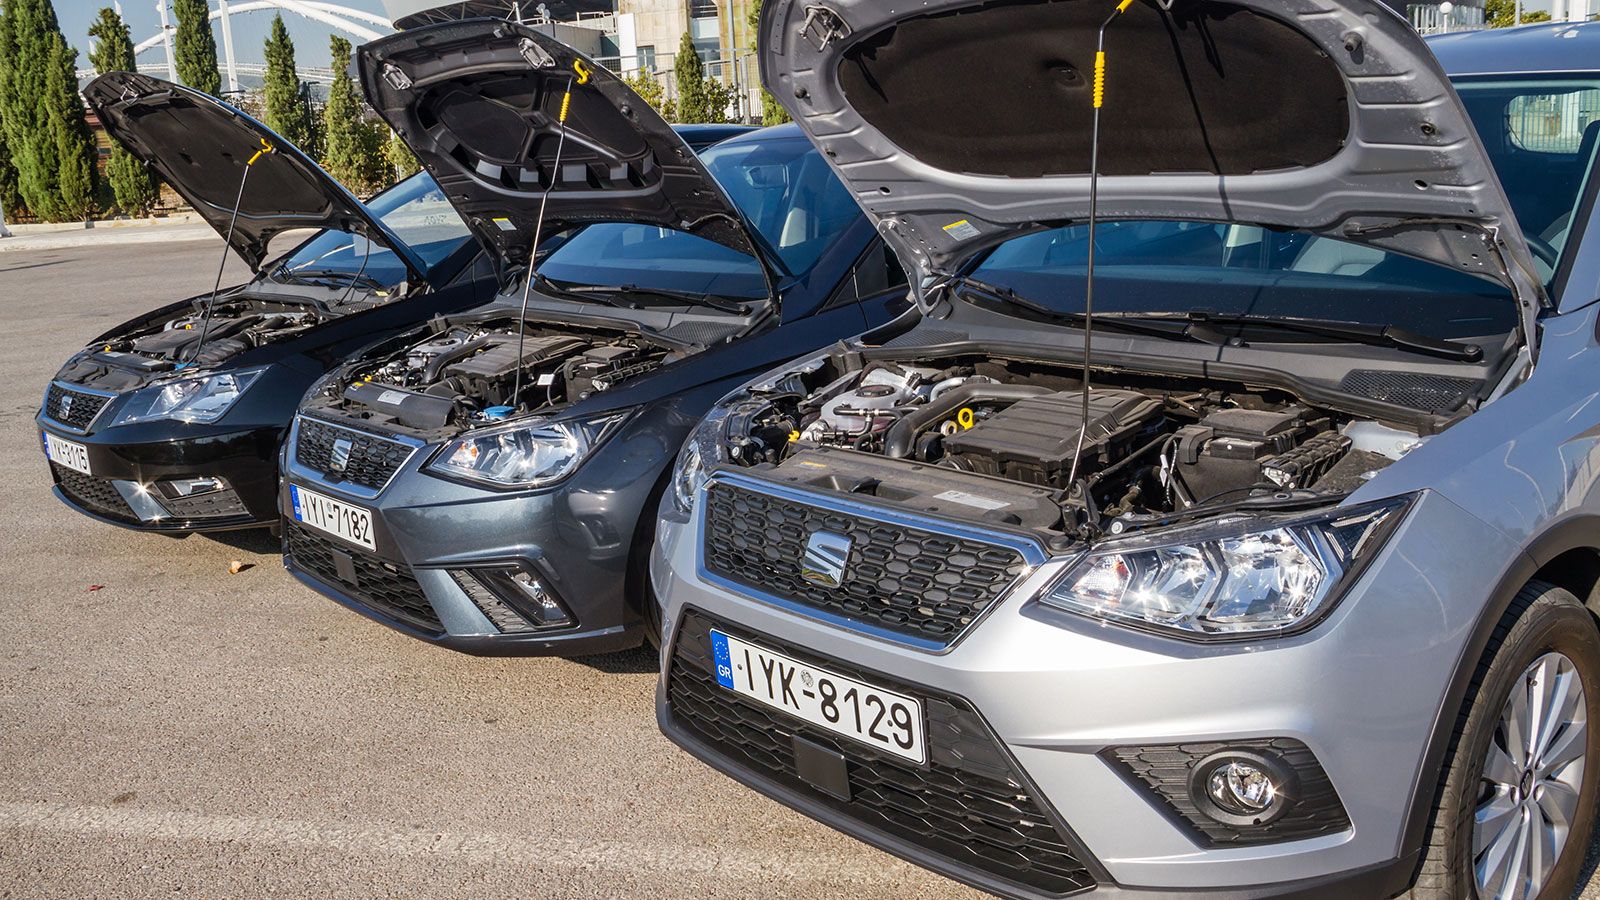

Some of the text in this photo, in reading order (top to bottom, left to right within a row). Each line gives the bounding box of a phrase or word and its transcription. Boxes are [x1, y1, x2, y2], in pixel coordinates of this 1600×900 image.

[304, 493, 371, 544] IYI-7182
[717, 664, 731, 680] GR
[744, 649, 914, 750] IYK-8129
